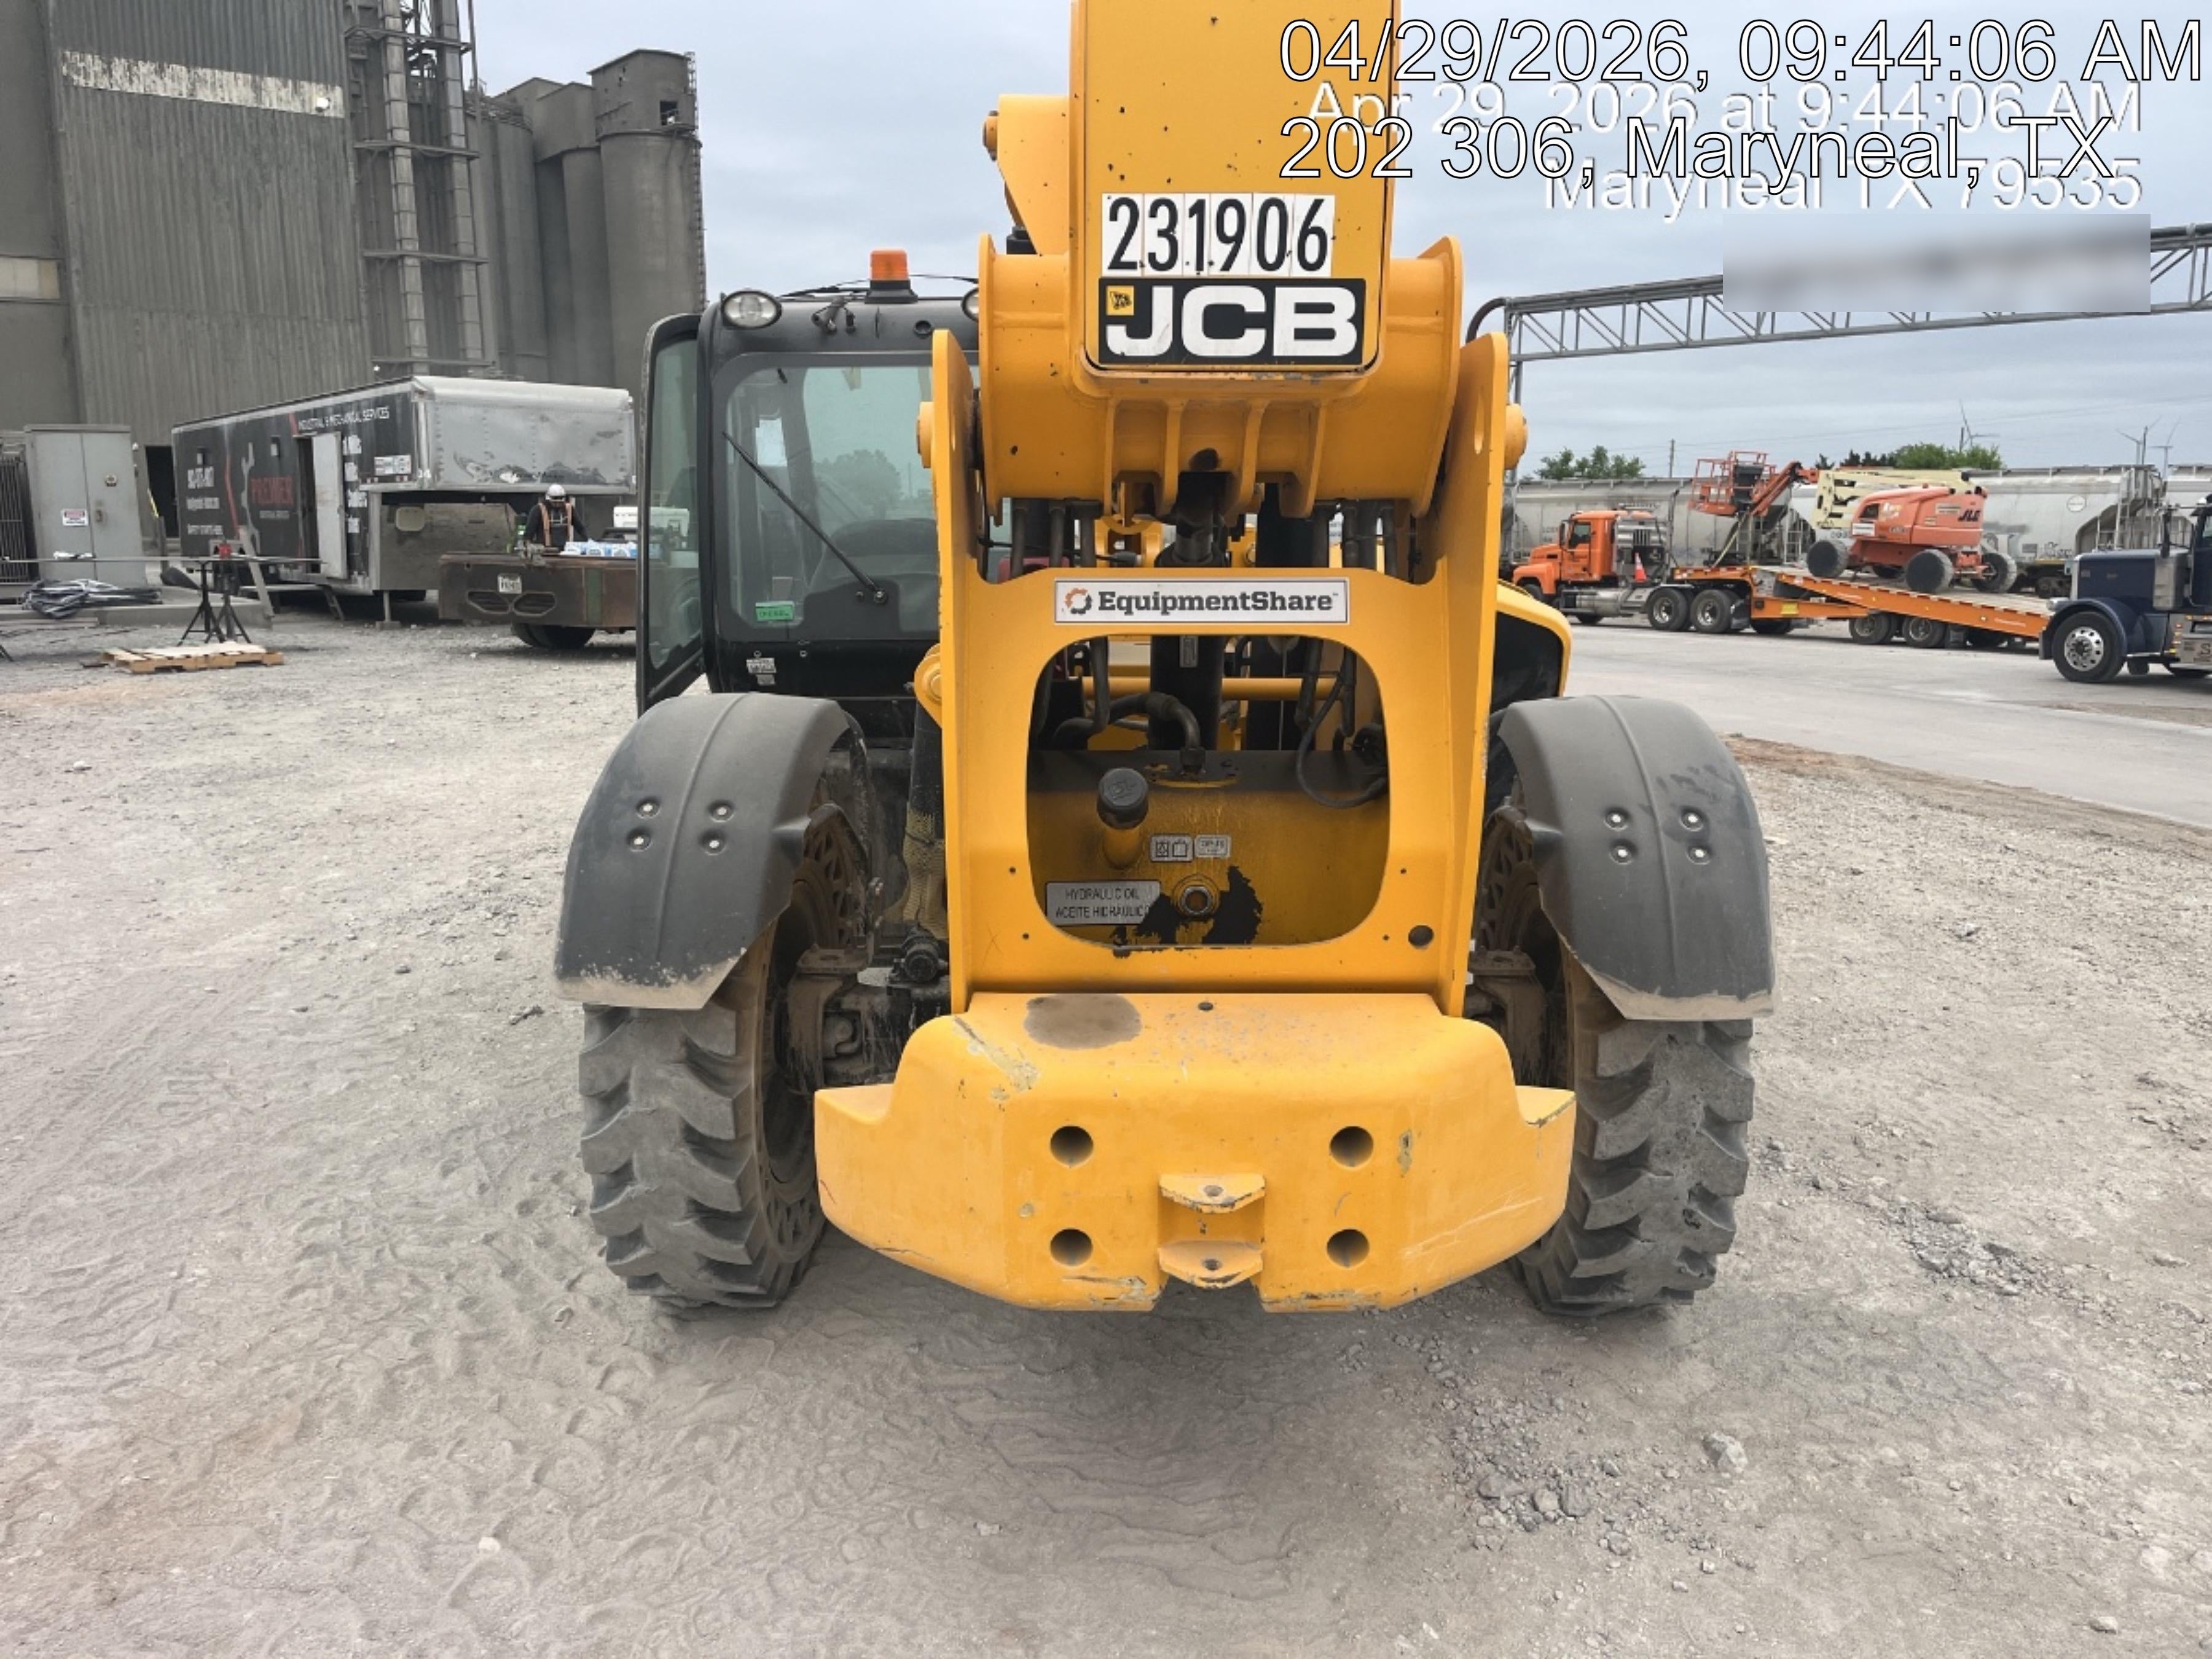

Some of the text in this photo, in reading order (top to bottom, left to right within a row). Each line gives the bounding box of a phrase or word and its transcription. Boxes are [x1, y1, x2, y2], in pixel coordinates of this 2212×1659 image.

[1107, 197, 1328, 272] 231906
[1106, 285, 1357, 356] JCB
[1098, 591, 1333, 616] EquipmentShare
[1065, 888, 1140, 901] HYDRAULIC OIL
[1055, 906, 1091, 919] ACEITE
